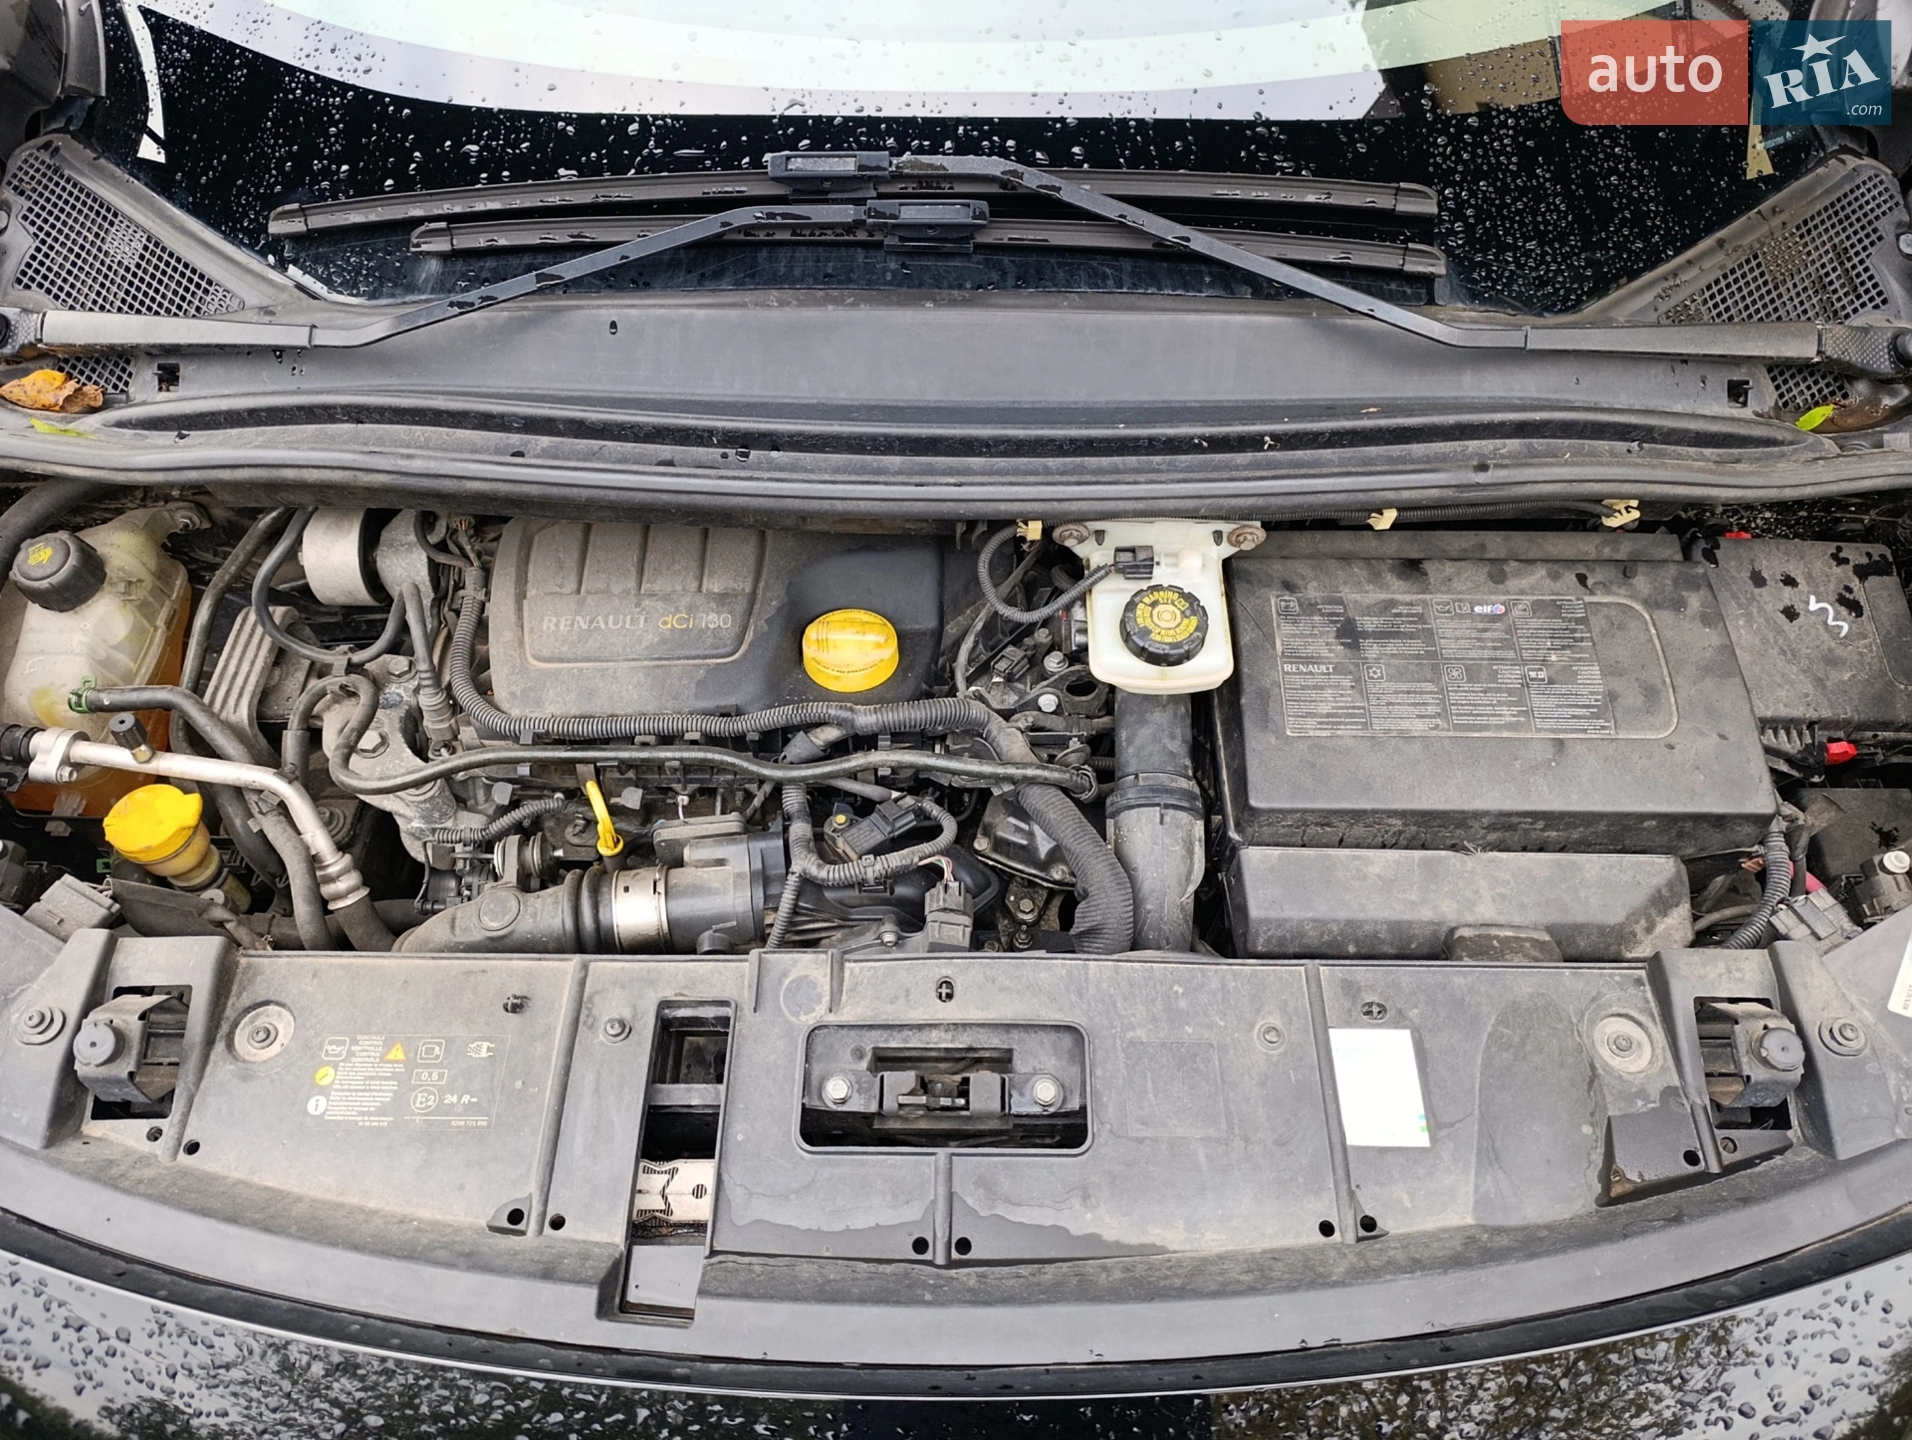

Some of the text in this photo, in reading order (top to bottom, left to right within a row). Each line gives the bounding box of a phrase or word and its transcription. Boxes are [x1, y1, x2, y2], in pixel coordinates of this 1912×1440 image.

[1474, 604, 1494, 614] elf
[542, 613, 732, 631] RENAULT dCi 130
[1283, 663, 1335, 673] RENAULT
[421, 1071, 439, 1082] 0,5
[414, 1092, 435, 1108] E2
[443, 1094, 458, 1104] 24
